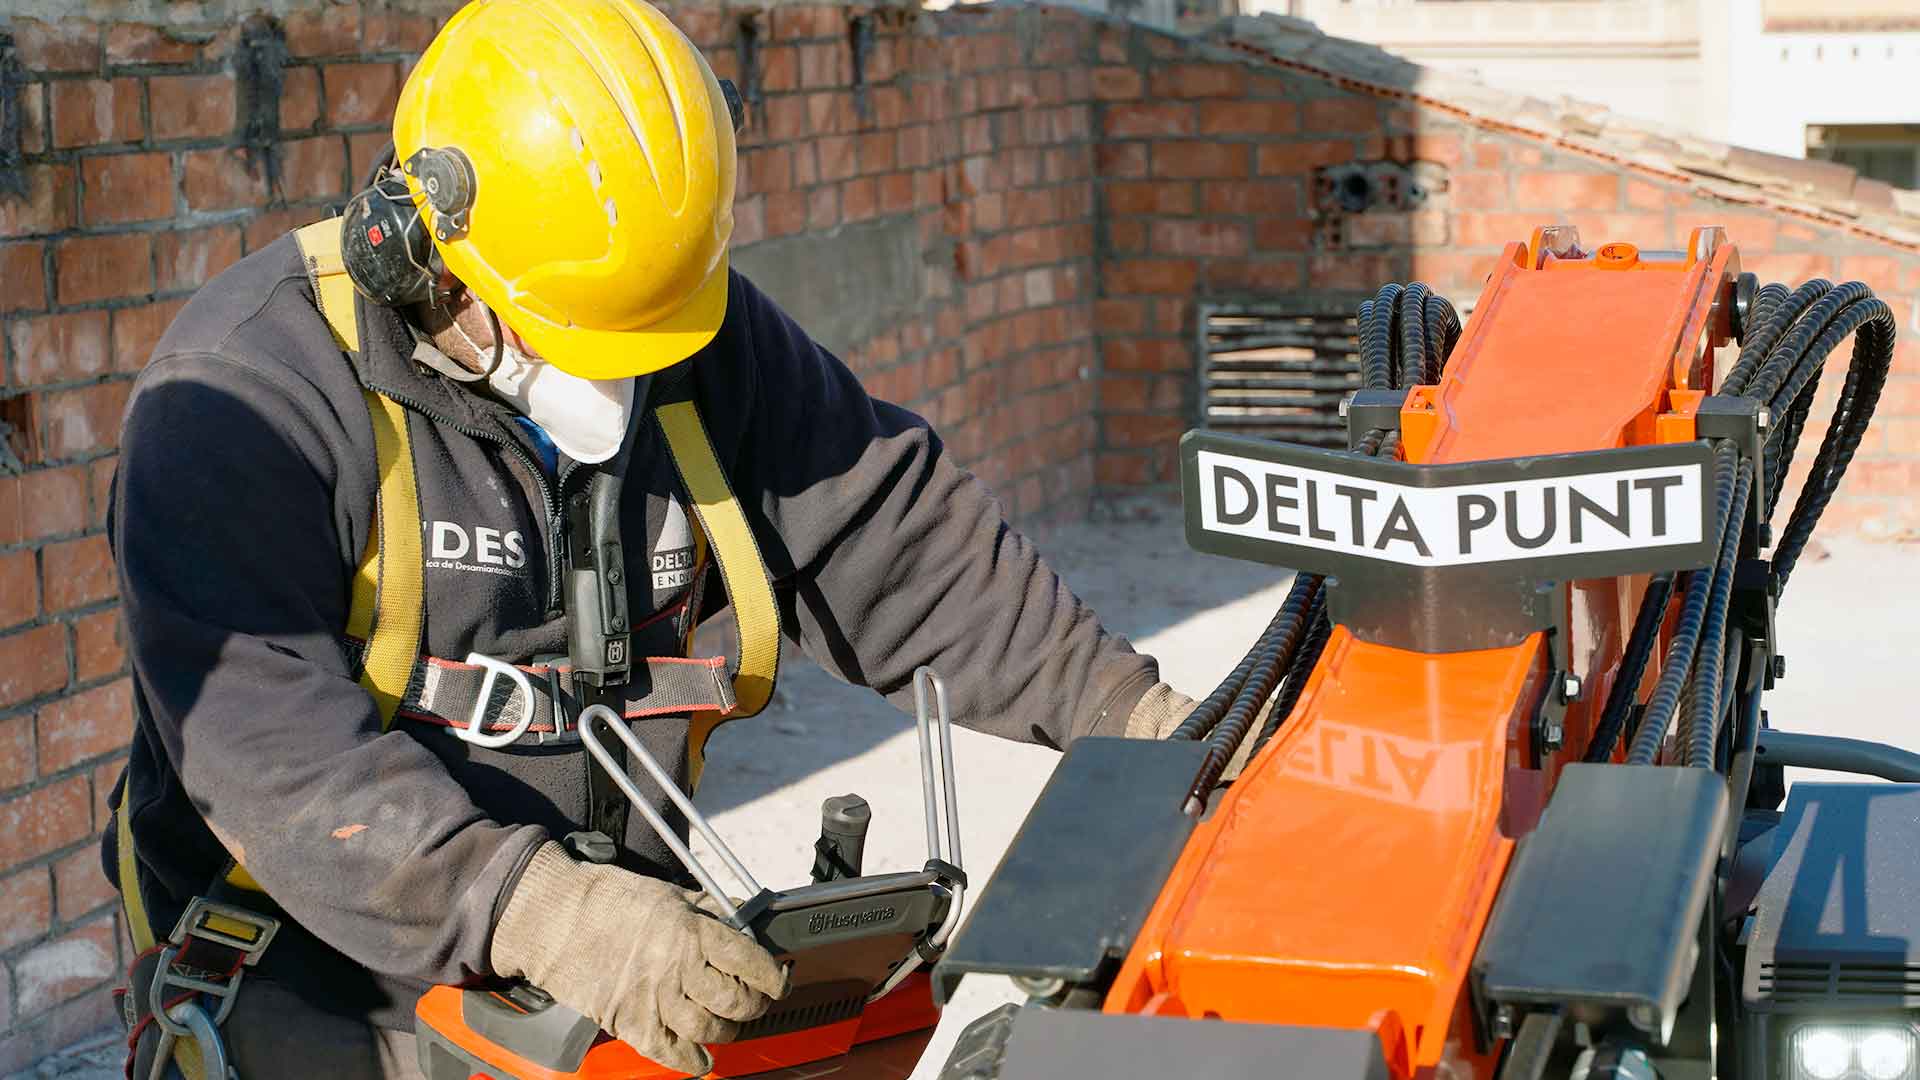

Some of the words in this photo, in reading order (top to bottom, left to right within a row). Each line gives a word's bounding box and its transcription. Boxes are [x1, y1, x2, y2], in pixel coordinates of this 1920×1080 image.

[1213, 464, 1433, 557] DELTA
[1456, 475, 1683, 554] PUNT
[423, 521, 527, 569] DES
[441, 561, 454, 569] de
[653, 551, 693, 571] DELTA
[658, 571, 693, 586] END
[826, 906, 896, 930] Husqvarna
